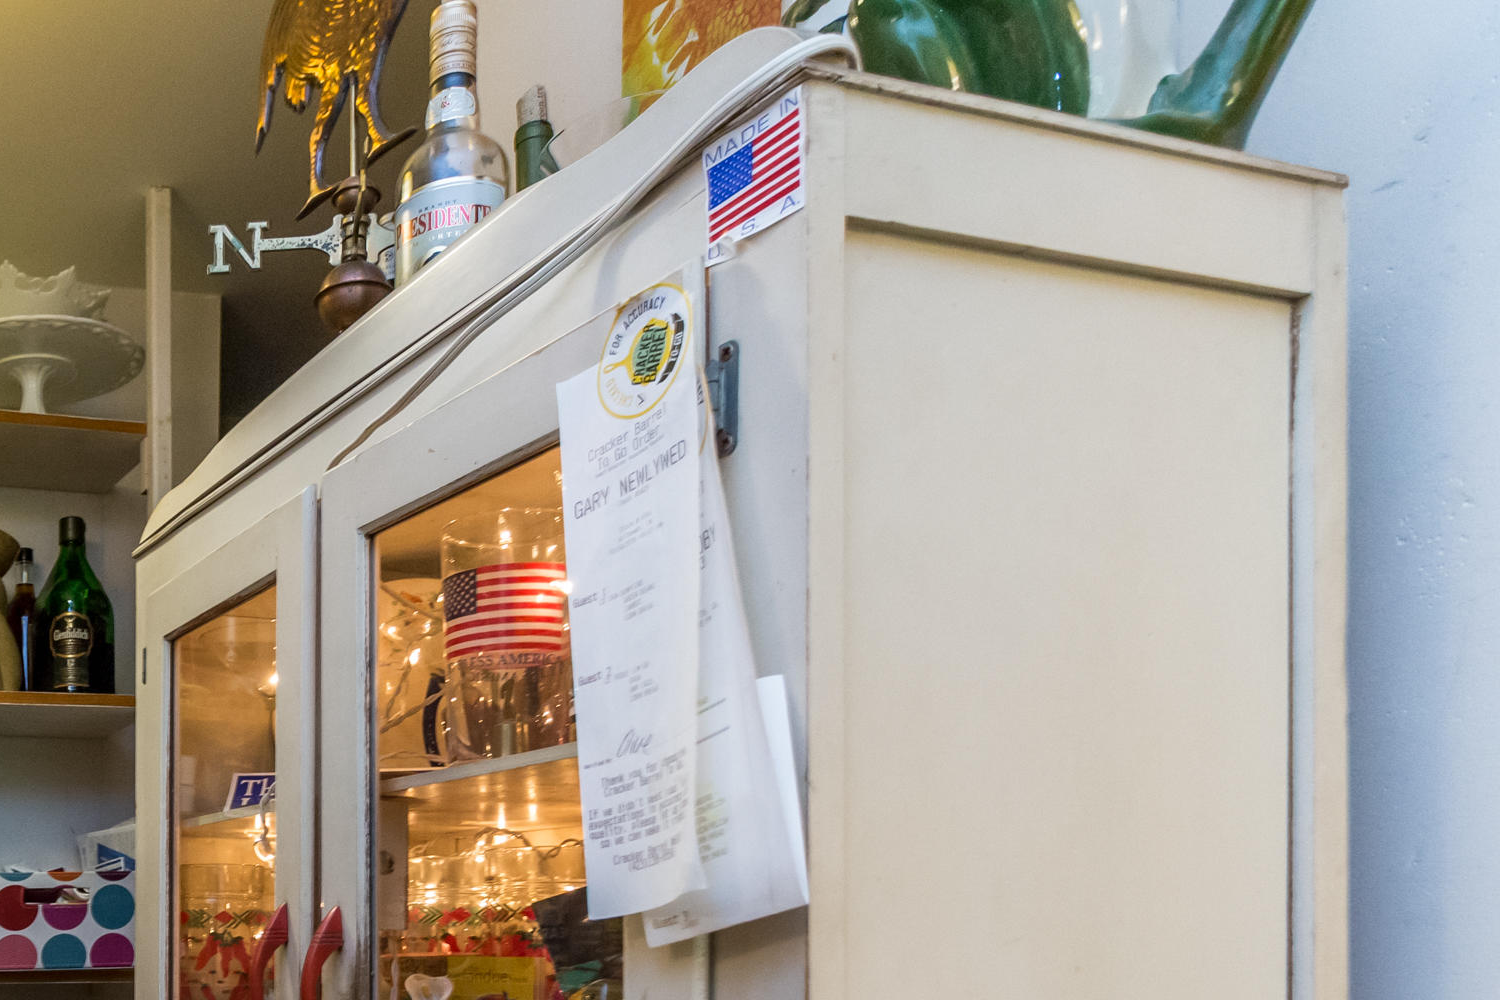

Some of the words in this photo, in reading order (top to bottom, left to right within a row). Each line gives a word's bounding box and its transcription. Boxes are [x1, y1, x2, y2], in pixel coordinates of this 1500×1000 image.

[704, 113, 770, 168] MADE
[779, 92, 799, 118] IN
[206, 221, 269, 275] N
[609, 333, 624, 356] FOR
[624, 295, 668, 331] ACCURACY
[588, 431, 629, 463] Cracker
[634, 402, 667, 436] Barrel
[614, 446, 628, 461] Go
[632, 424, 661, 451] Order
[573, 486, 610, 520] GARY
[619, 439, 686, 498] NEWLYWED
[572, 592, 597, 609] Guest
[577, 671, 603, 687] Guest
